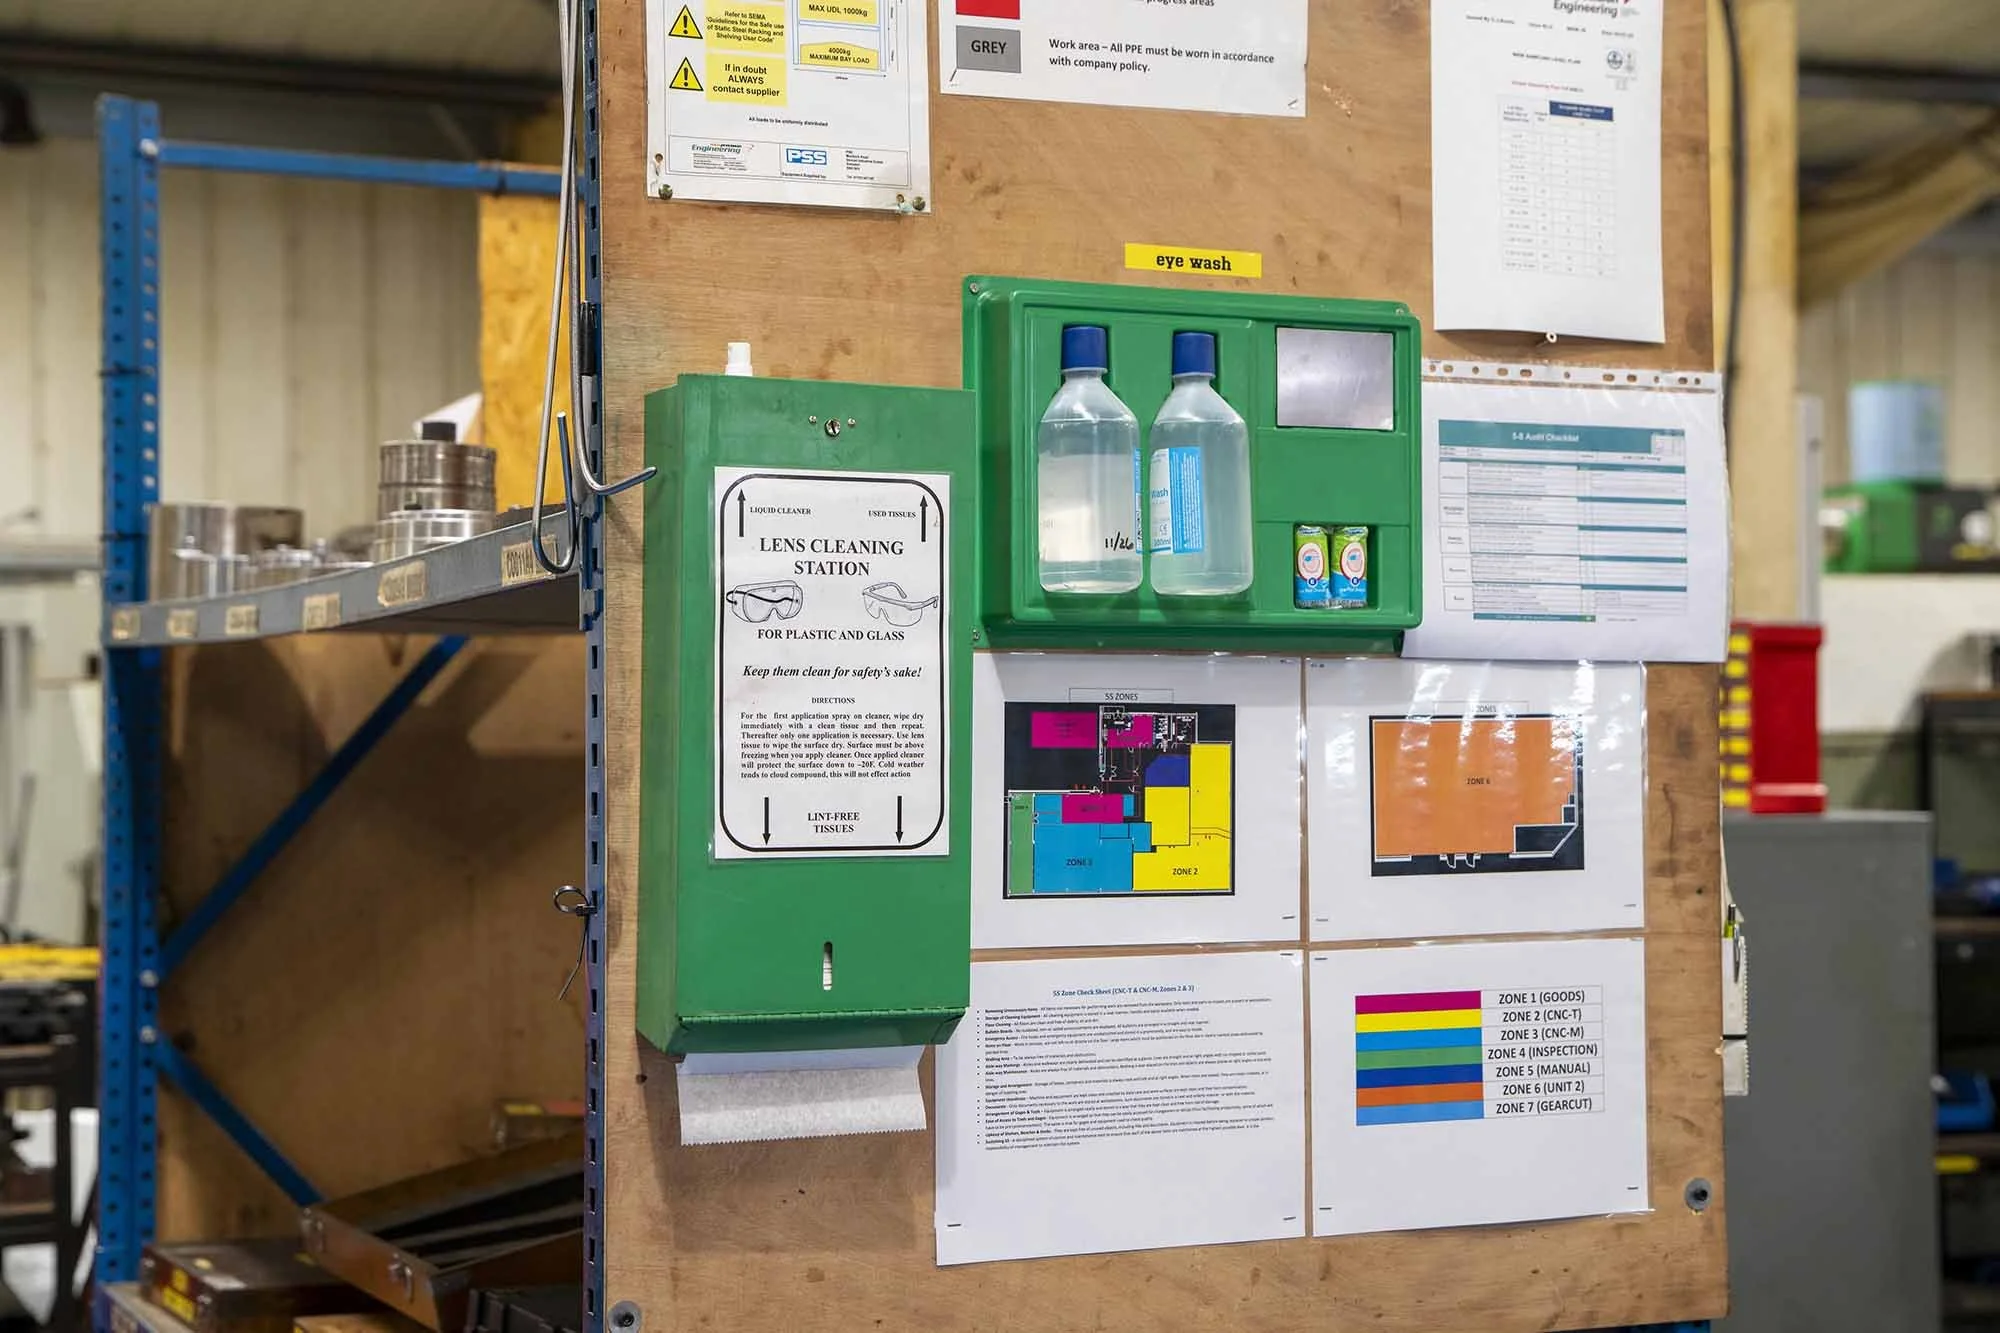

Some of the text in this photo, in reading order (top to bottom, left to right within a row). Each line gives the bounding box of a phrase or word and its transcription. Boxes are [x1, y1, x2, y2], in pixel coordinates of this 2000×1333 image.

[808, 4, 825, 12] MAX
[843, 8, 868, 17] 1000kg
[1553, 0, 1618, 18] Engineering
[716, 32, 757, 41] Shelving User
[747, 28, 772, 37] Racking
[828, 47, 851, 56] 4000kg
[970, 39, 1007, 55] GREY
[1049, 38, 1274, 64] Work area All PPE must be worn in accordance
[809, 53, 838, 61] MAXIMUM
[733, 64, 740, 72] in
[742, 65, 767, 75] doubt
[1049, 56, 1150, 73] with company policy.
[728, 74, 764, 85] ALWAYS
[712, 85, 780, 97] contact supplier
[691, 144, 742, 154] Engineering
[786, 148, 827, 165] PSS
[1156, 255, 1232, 271] eye wash
[750, 506, 811, 515] LIQUID CLEANER
[760, 537, 905, 556] LENS CLEANING
[794, 560, 870, 576] STATION
[757, 629, 905, 641] FOR PLASTIC AND GLASS
[743, 666, 770, 679] Keep
[772, 666, 799, 677] them
[802, 666, 830, 677] clean
[832, 666, 850, 679] for
[893, 667, 922, 678] sake!
[1115, 693, 1138, 701] ZONES
[740, 712, 753, 720] For
[756, 712, 768, 720] the
[773, 712, 788, 720] first
[790, 712, 829, 721] application
[865, 712, 891, 721] cleaner,
[893, 712, 910, 721] wipe
[912, 712, 924, 721] dry
[740, 721, 925, 731] immediately with clean tissue and then repeat.
[741, 731, 778, 739] Thereafter
[780, 731, 795, 741] only
[812, 731, 850, 741] application
[860, 733, 894, 741] necessary.
[896, 731, 909, 739] Use
[911, 731, 925, 739] lens
[741, 741, 761, 749] tissue
[772, 741, 789, 750] wipe
[790, 741, 802, 749] the
[804, 741, 829, 749] surface
[831, 741, 845, 750] dry.
[847, 741, 873, 749] Surface
[904, 741, 925, 749] above
[741, 751, 769, 760] freezing
[805, 751, 824, 760] apply
[873, 751, 899, 760] applied
[741, 760, 924, 770] will protect the surface down Cold weather
[741, 770, 760, 778] tends
[770, 770, 789, 778] cloud
[790, 770, 828, 780] compound,
[829, 770, 842, 778] this
[844, 770, 857, 778] will
[870, 770, 889, 778] effect
[890, 770, 911, 778] action
[1466, 777, 1491, 785] ZONE 6
[807, 812, 860, 822] LINT-FREE
[813, 824, 855, 833] TISSUES
[1065, 858, 1087, 866] ZONE
[1172, 868, 1192, 876] ZONE
[1499, 989, 1585, 1005] ZONE 1 (GOODS)
[1503, 1008, 1582, 1023] ZONE 2 (CNC-T)
[1500, 1026, 1585, 1041] ZONE 3 (CNC-M)
[1487, 1043, 1598, 1060] ZONE 4 (INSPECTION)
[1496, 1062, 1591, 1078] ZONE 5 (MANUAL)
[1503, 1079, 1585, 1096] ZONE 6 (UNIT 2)
[1496, 1098, 1592, 1114] ZONE 7 (GEARCUT)
